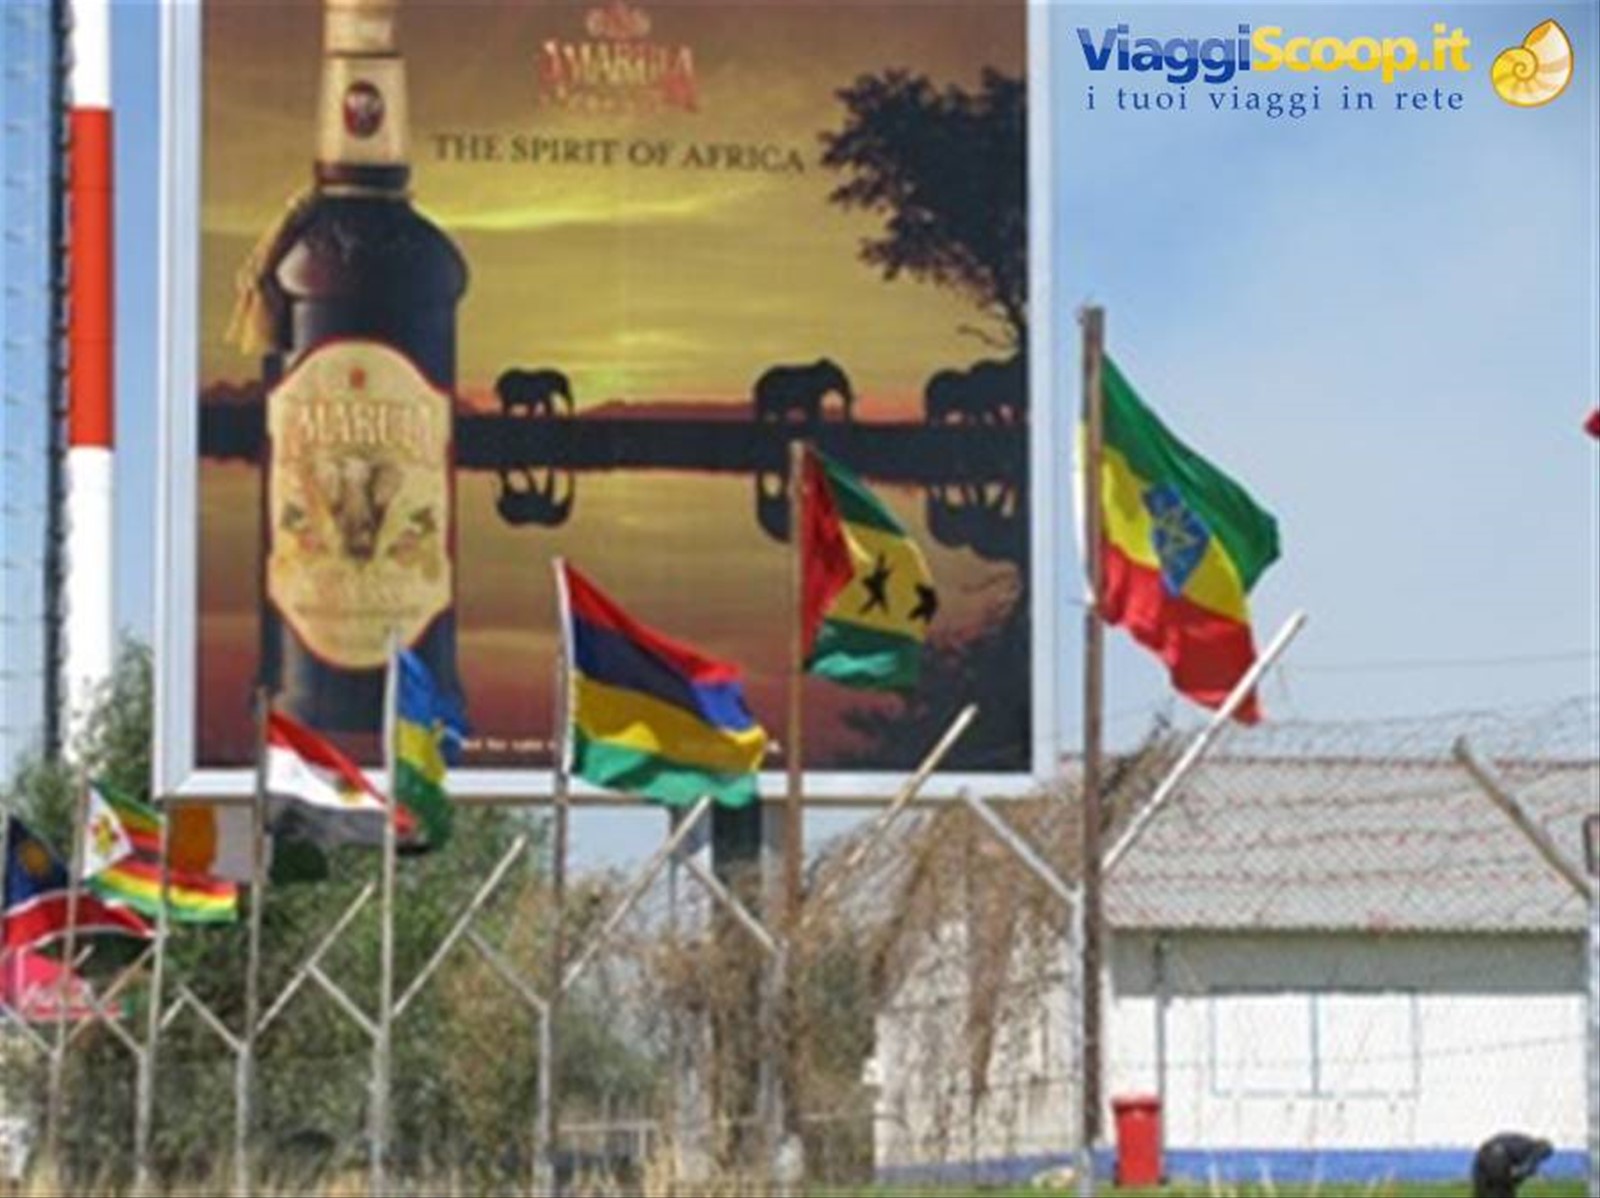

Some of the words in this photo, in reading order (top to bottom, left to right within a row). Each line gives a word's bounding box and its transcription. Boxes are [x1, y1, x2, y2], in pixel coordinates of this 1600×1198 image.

[433, 133, 502, 163] THE
[510, 135, 621, 168] SPIRIT
[627, 141, 671, 168] OF
[681, 142, 806, 174] AFRICA
